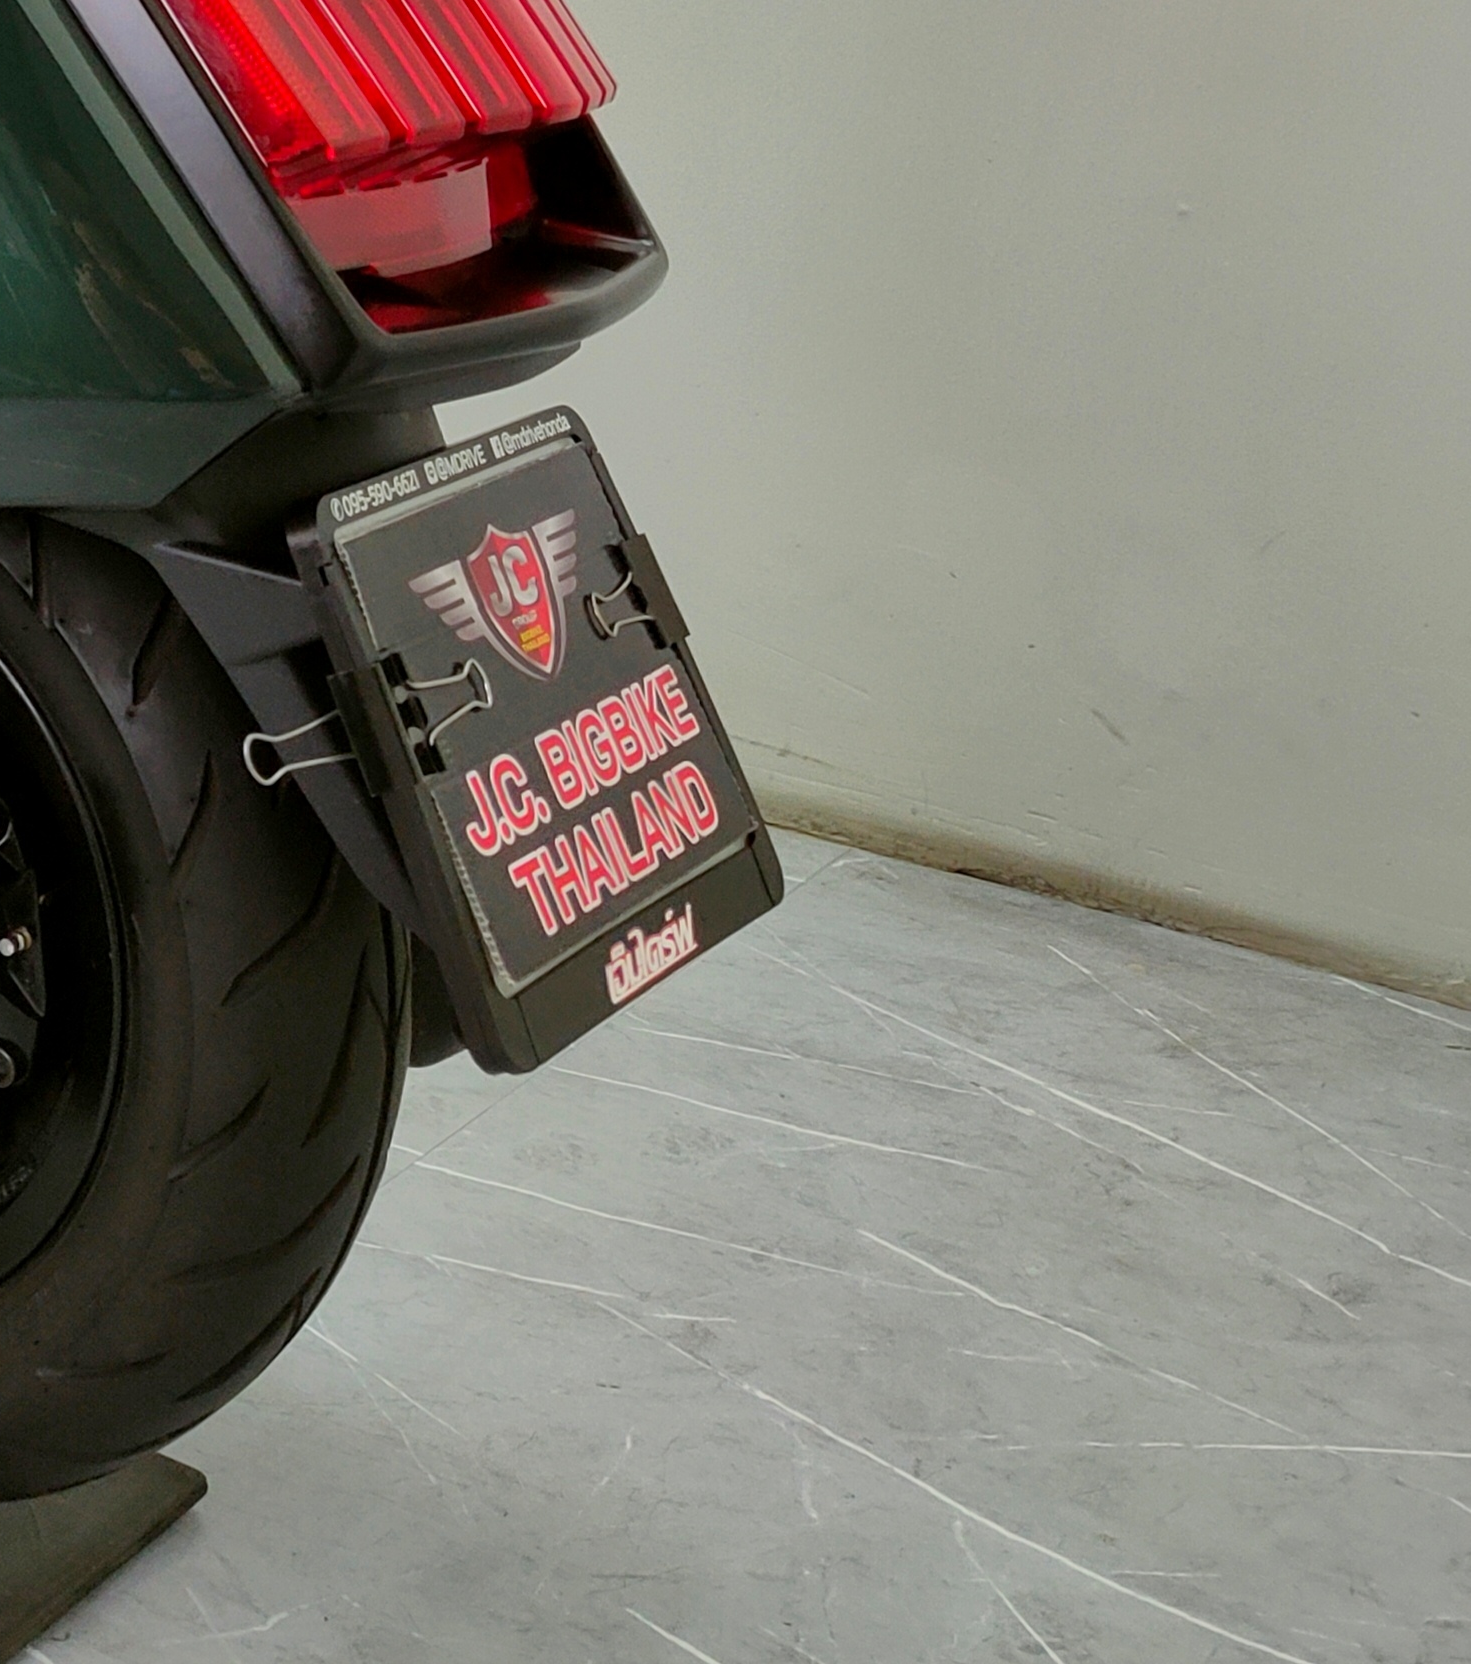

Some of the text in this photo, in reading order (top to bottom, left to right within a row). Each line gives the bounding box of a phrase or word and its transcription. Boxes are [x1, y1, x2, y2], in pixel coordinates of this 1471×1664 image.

[487, 544, 539, 617] JC
[465, 663, 701, 857] J.C. BIGBIKE
[508, 760, 720, 937] THAILAND
